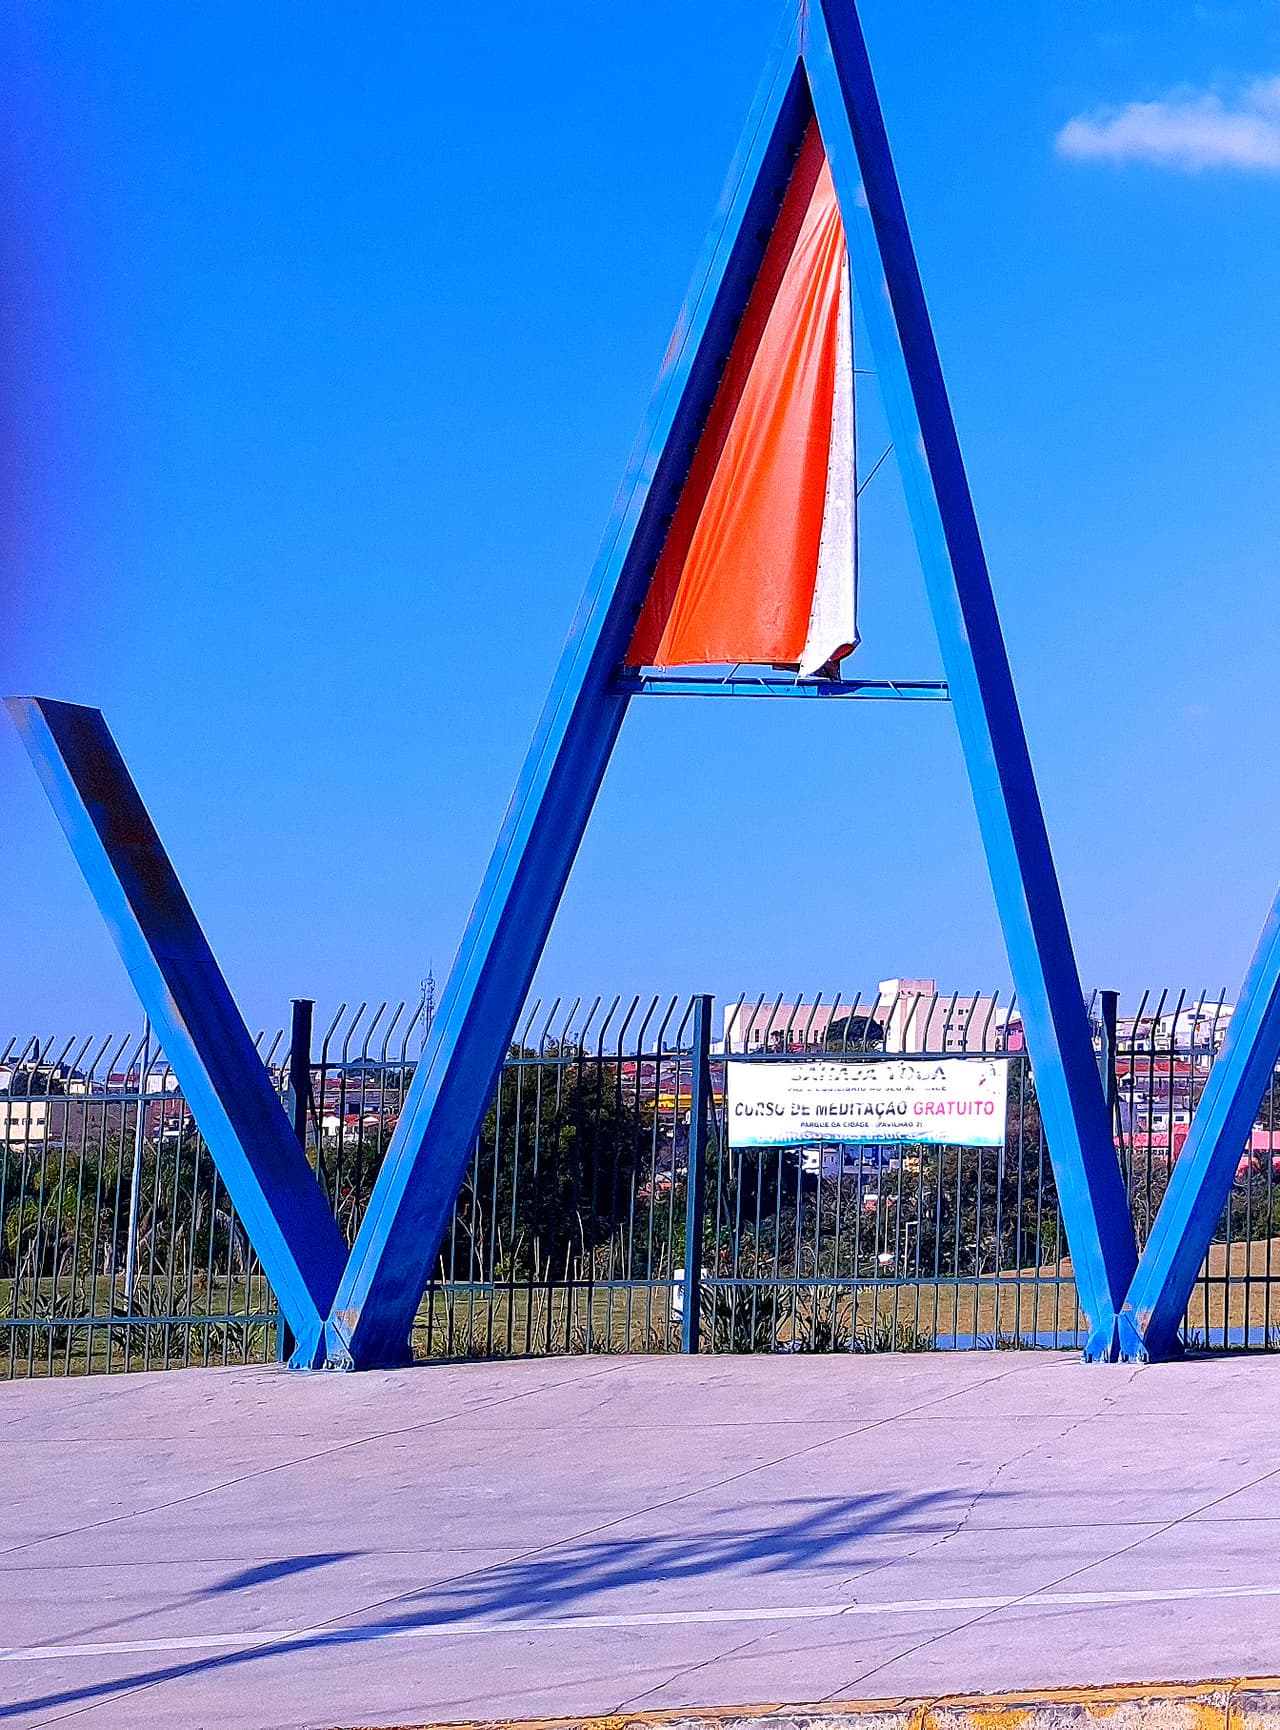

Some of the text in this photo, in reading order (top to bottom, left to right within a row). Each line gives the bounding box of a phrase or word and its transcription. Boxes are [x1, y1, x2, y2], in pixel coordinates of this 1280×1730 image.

[735, 1101, 785, 1116] CURSO
[790, 1102, 811, 1116] DE
[913, 1100, 995, 1116] GRATUITO
